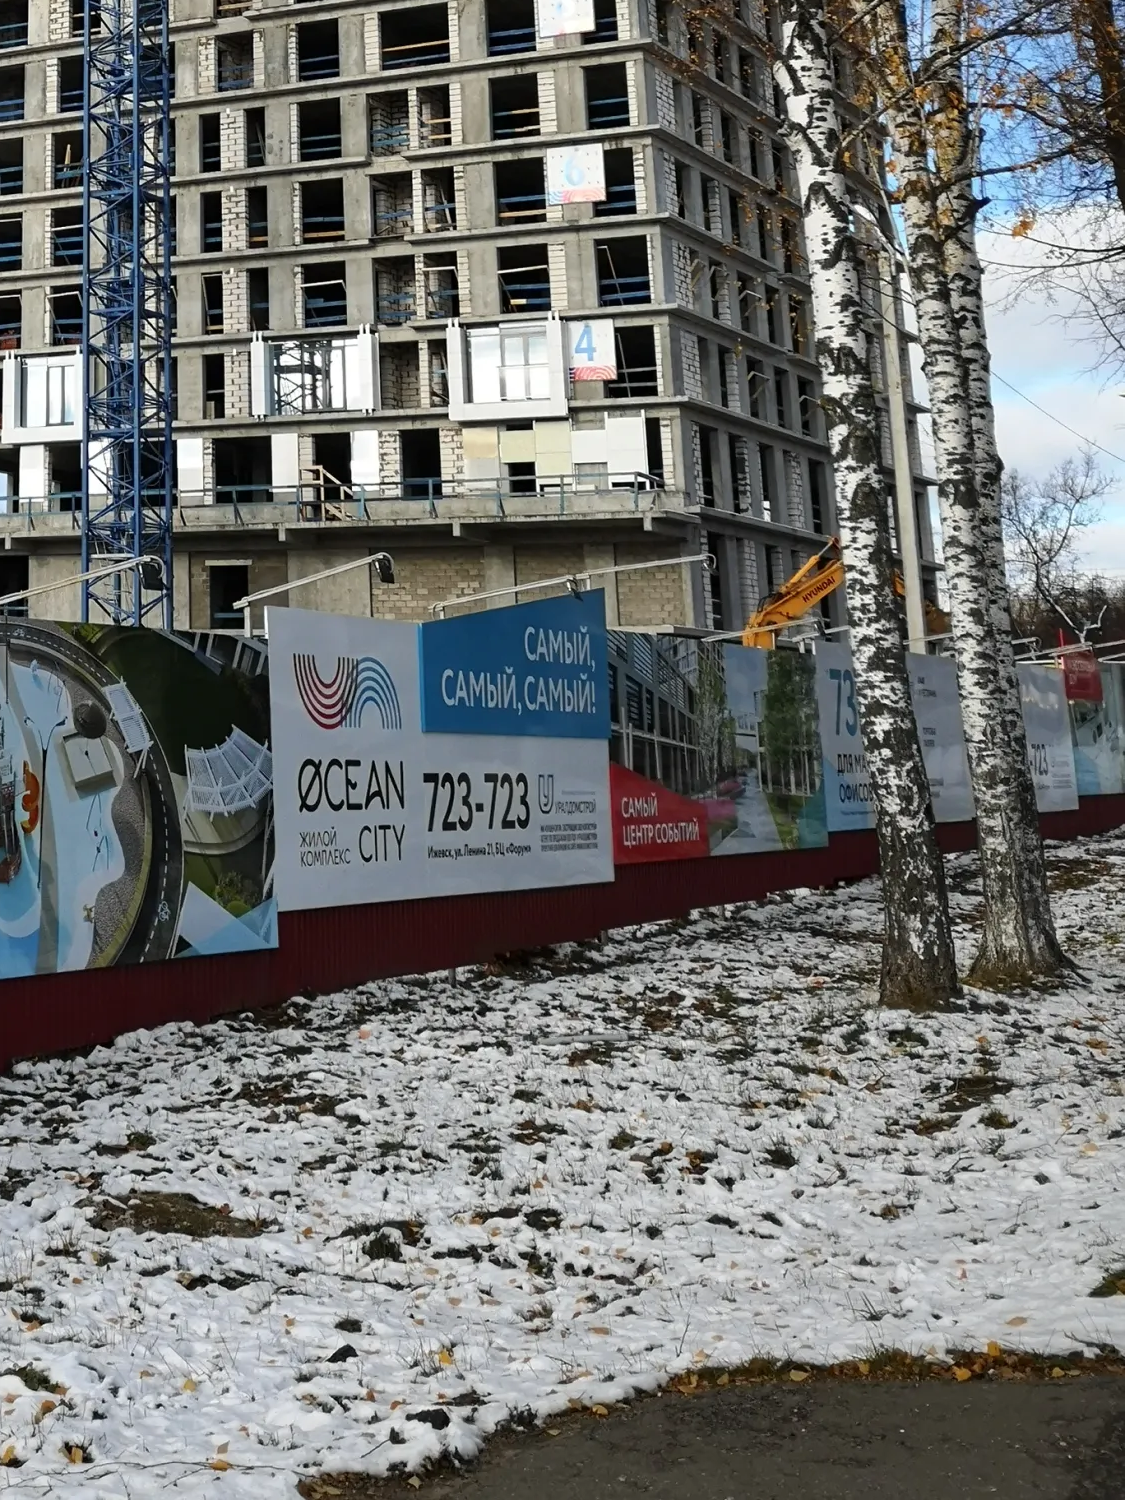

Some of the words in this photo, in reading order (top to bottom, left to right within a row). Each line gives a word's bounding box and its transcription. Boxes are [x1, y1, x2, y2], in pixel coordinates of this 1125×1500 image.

[564, 154, 586, 187] 6
[574, 323, 597, 362] 4
[802, 576, 835, 603] HYUNDAI
[525, 625, 595, 672] САМЫЙ,
[441, 665, 521, 715] САМЫЙ,
[524, 672, 596, 714] САМЫЙ!
[837, 754, 853, 776] ДЛЯ
[423, 772, 531, 832] 723-723
[621, 792, 658, 818] САМЫЙ
[299, 826, 337, 848] ЖИЛОЙ
[358, 823, 406, 863] CITY
[623, 825, 654, 849] ЦЕНТР
[655, 817, 700, 844] СОБЫТИЙ
[300, 848, 351, 867] КОМПЛЕКС
[428, 845, 454, 859] Ижевск,
[454, 847, 463, 860] ул.
[464, 843, 486, 856] Ленина
[495, 842, 505, 856] БЦ
[506, 842, 531, 856] «Форум»
